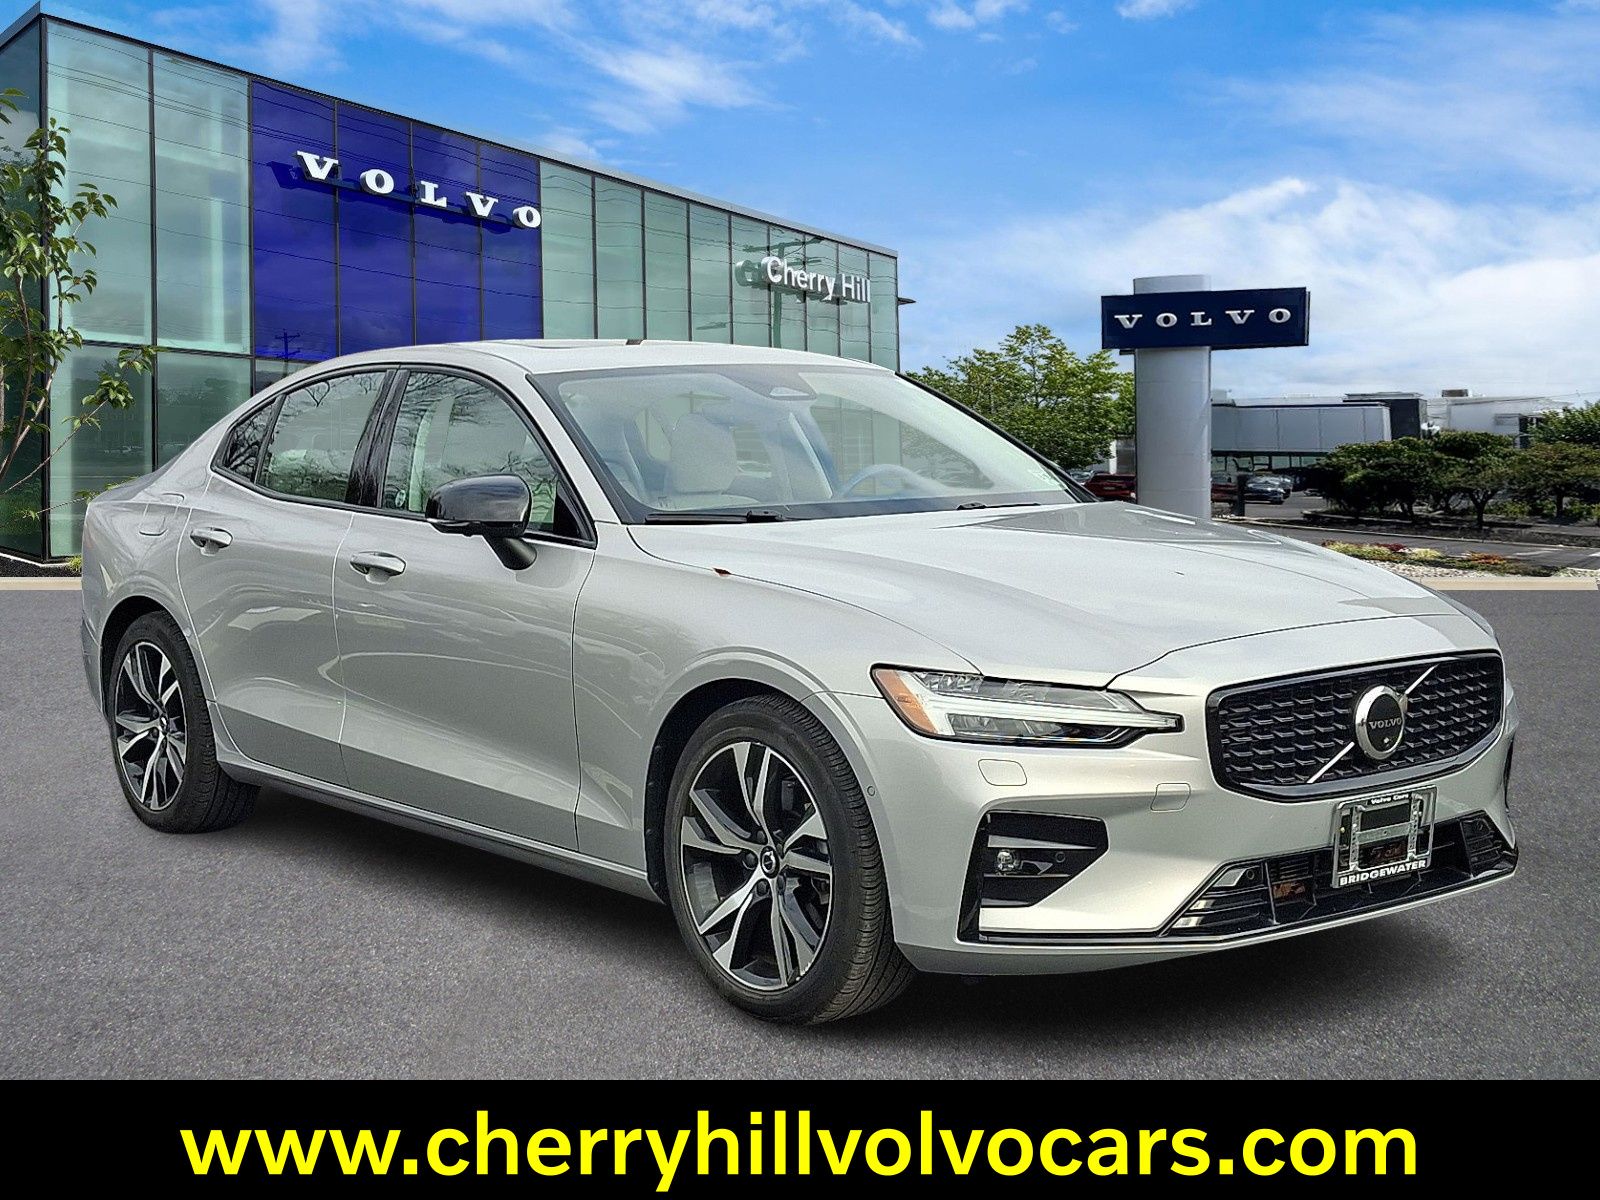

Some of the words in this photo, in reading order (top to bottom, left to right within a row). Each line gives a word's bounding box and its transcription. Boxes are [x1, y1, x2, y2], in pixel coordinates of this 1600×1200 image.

[296, 150, 542, 229] VOLVO
[763, 256, 835, 301] Cherry
[841, 273, 871, 303] Hill
[1114, 307, 1292, 329] VOLVO
[1368, 717, 1402, 730] VOLVO
[1339, 859, 1427, 886] BRIDGEWATER
